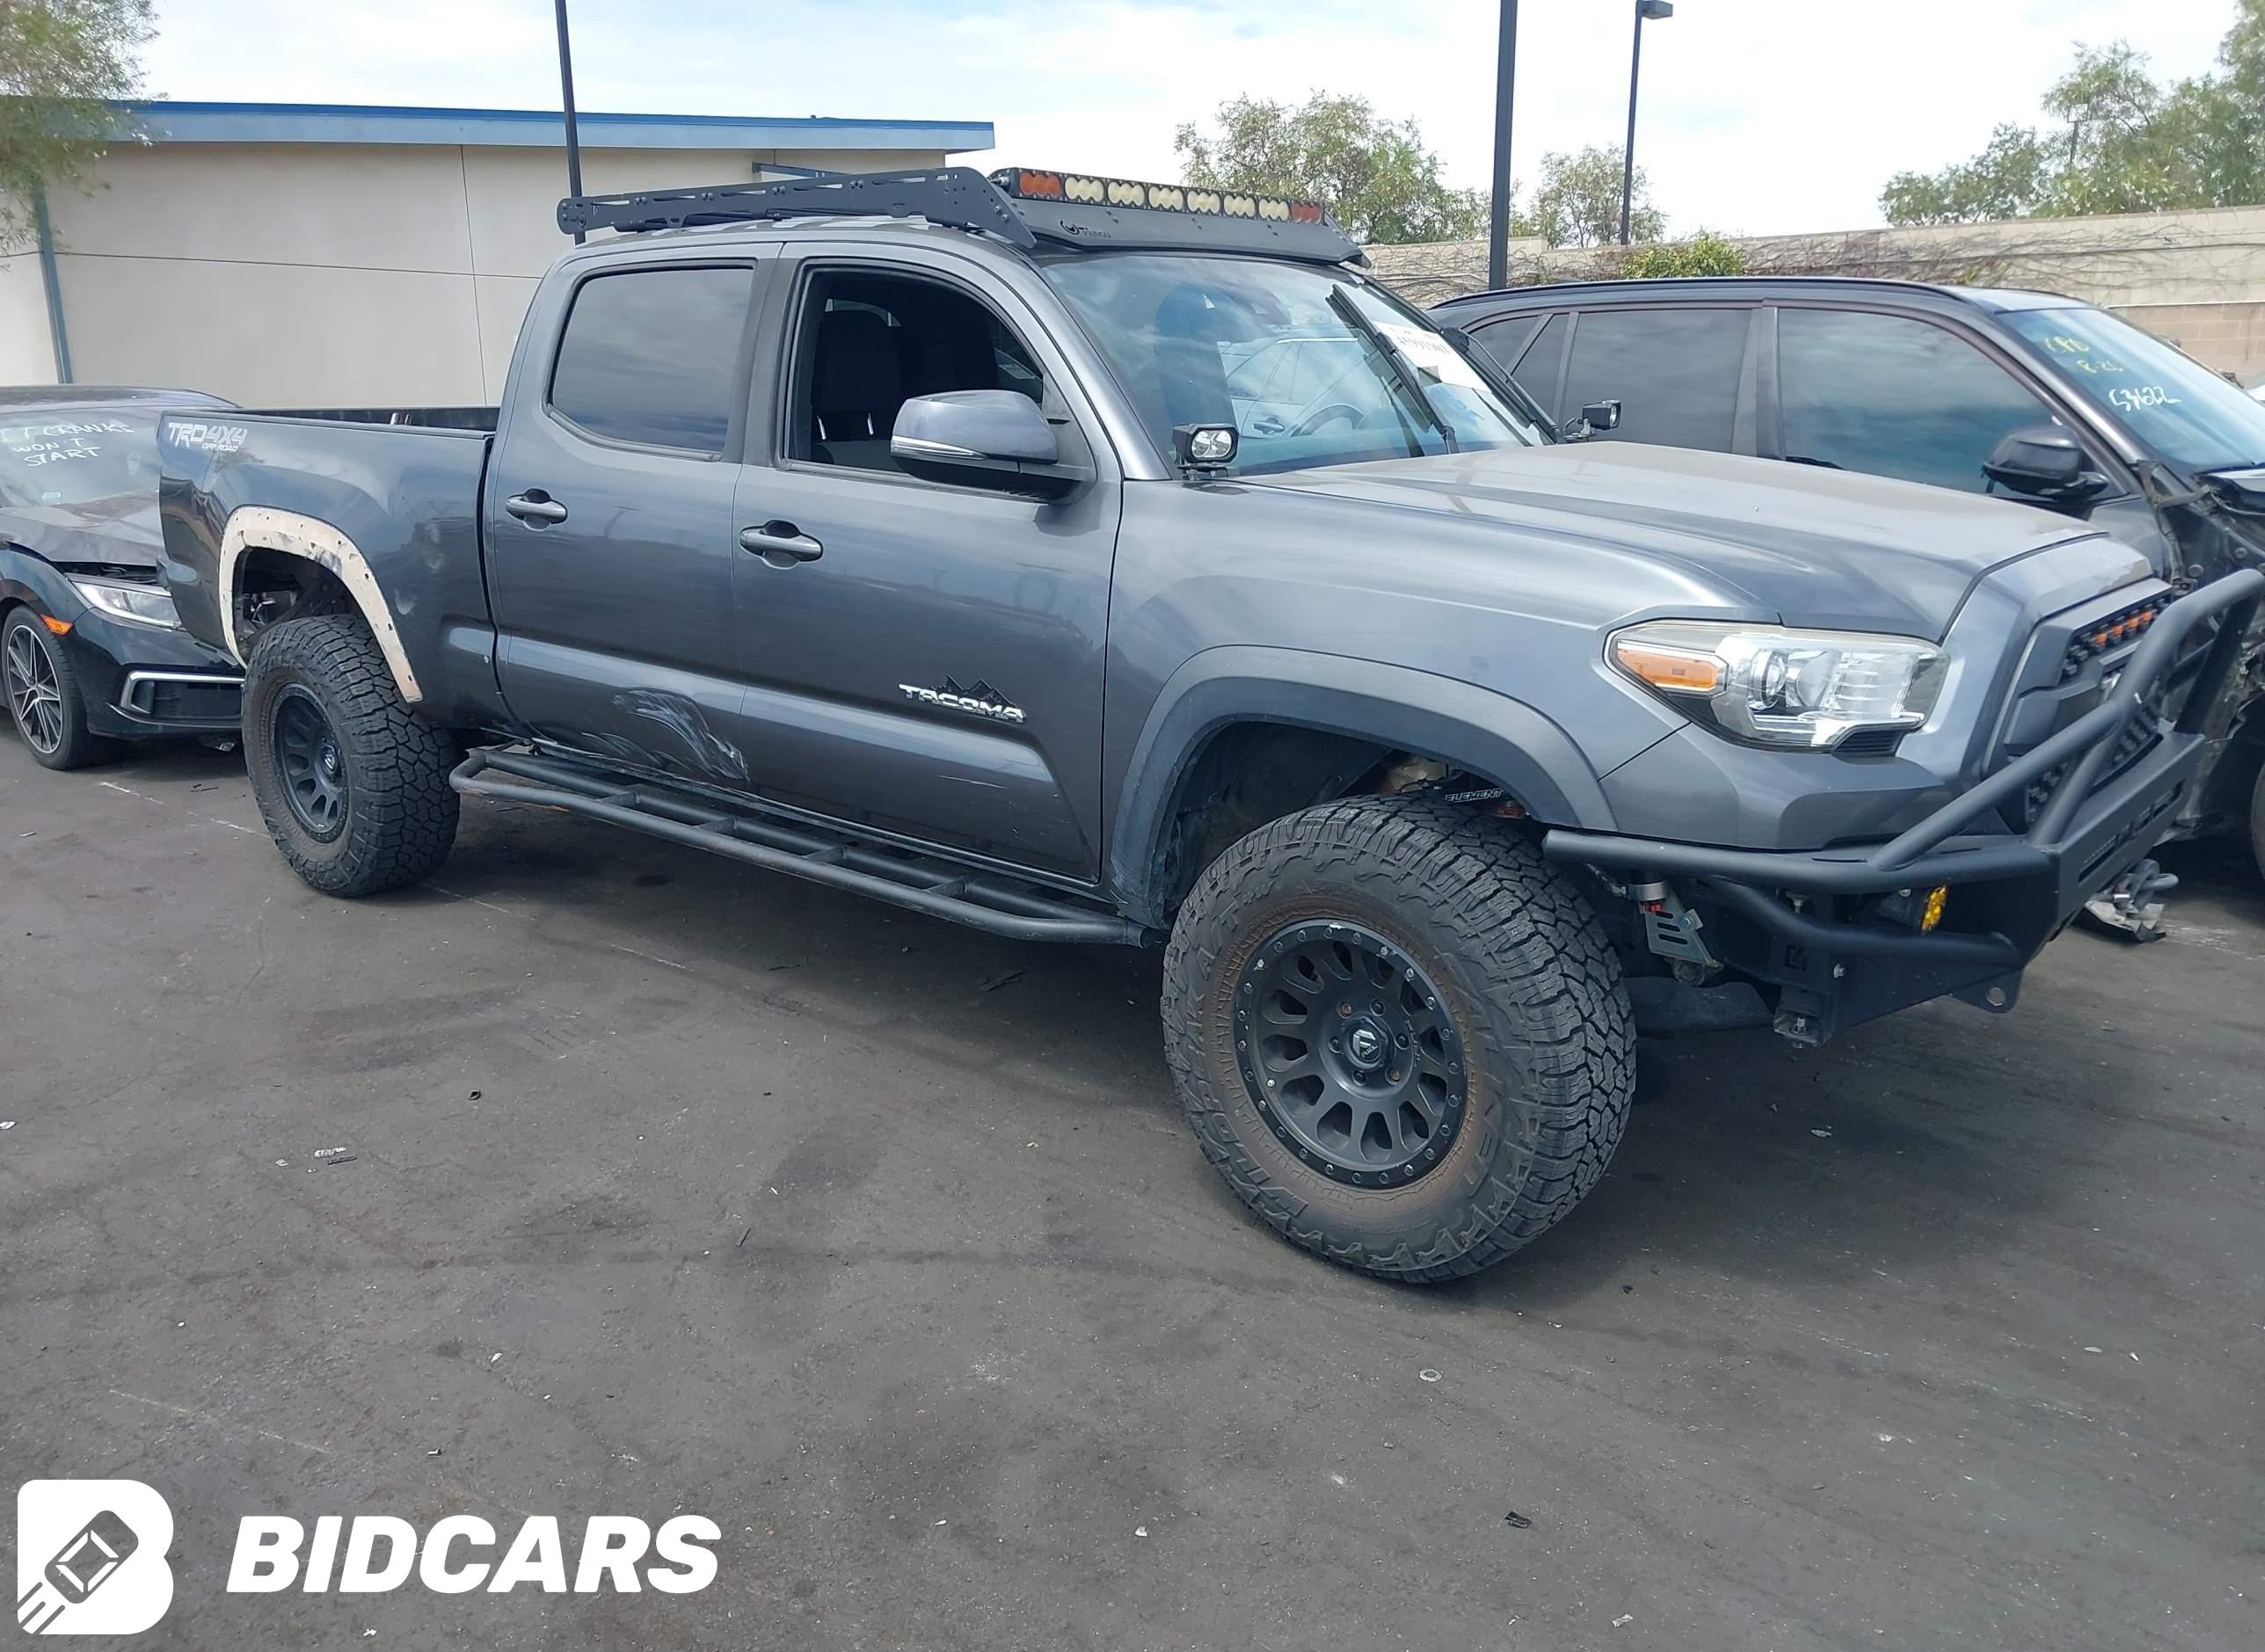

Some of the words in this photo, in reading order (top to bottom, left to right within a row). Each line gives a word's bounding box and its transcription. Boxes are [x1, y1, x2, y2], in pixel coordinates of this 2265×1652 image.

[43, 423, 135, 436] CRANKS
[169, 422, 208, 448] TRD
[24, 447, 101, 466] START
[899, 683, 1026, 724] TACOMA
[1445, 788, 1504, 803] ELEMENT
